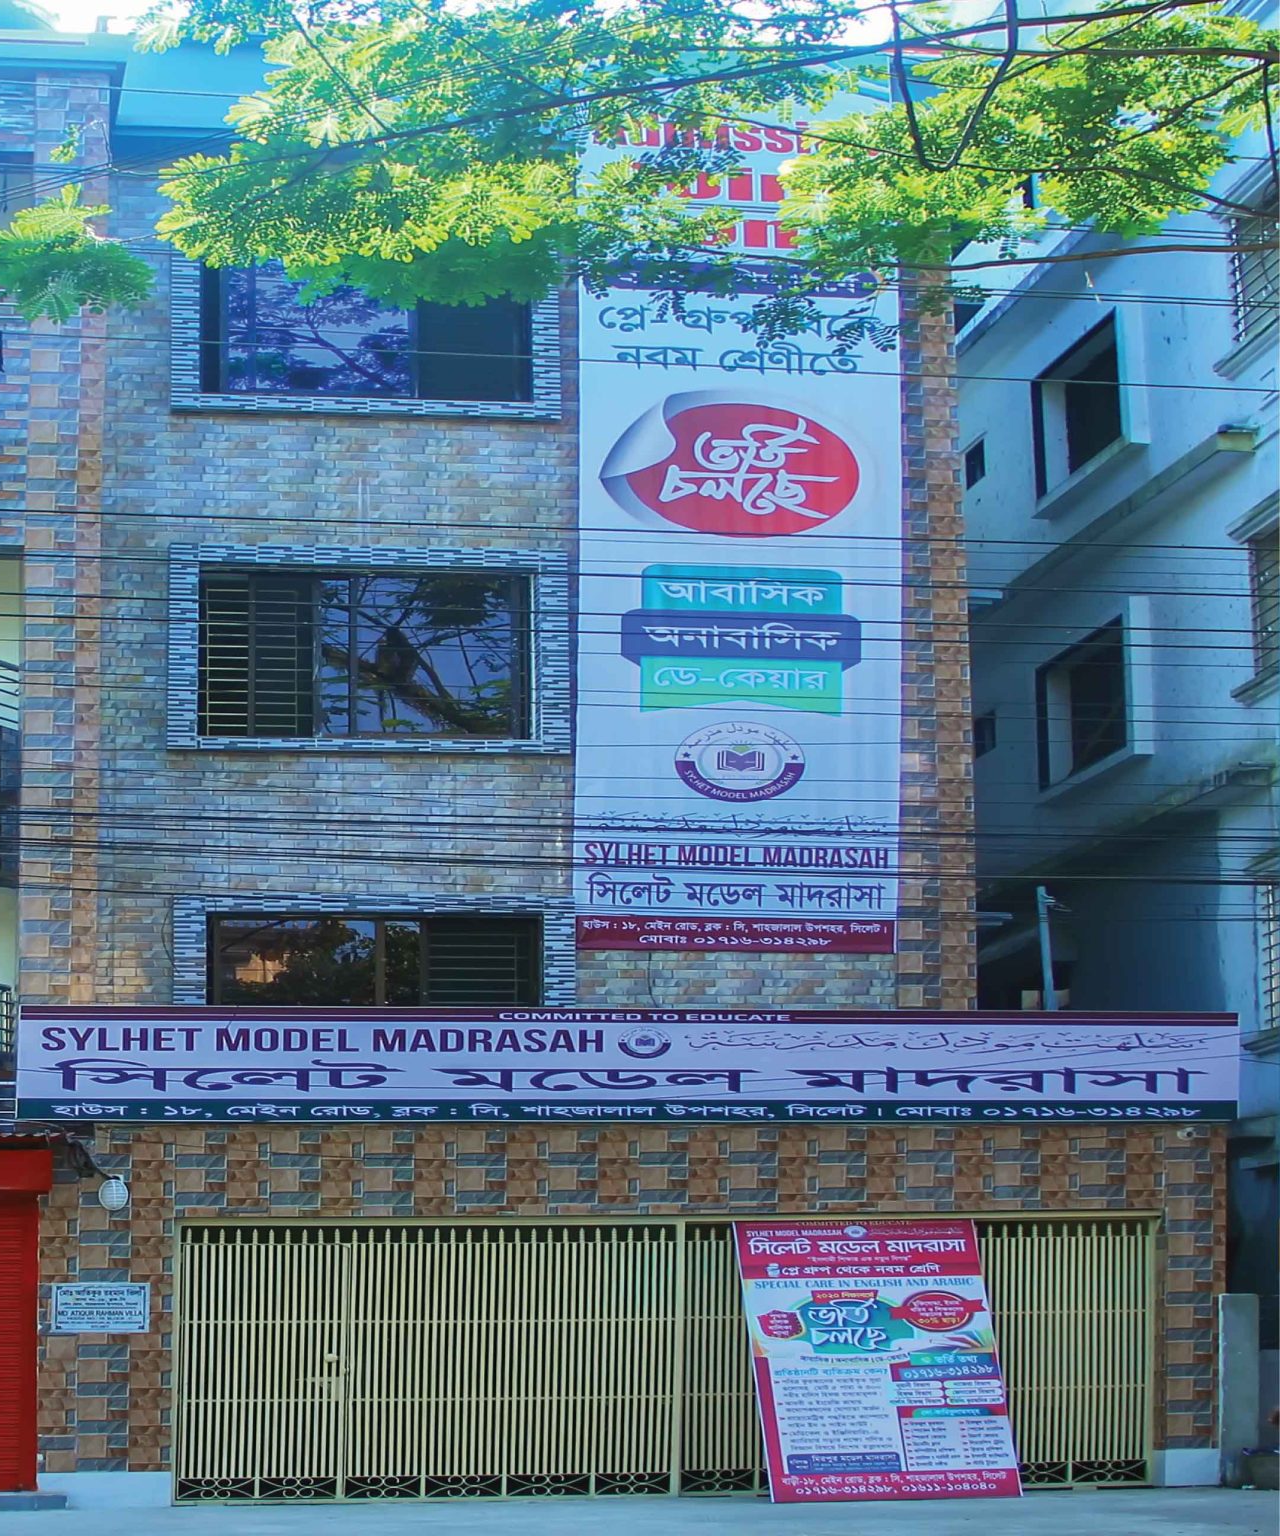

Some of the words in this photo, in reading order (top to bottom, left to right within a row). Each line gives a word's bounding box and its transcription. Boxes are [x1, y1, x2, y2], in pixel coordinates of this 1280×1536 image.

[611, 345, 705, 371] নবম
[719, 342, 864, 376] শ্রেণীতে
[659, 464, 840, 519] চলছে
[657, 578, 829, 606] আবাসিক
[641, 622, 842, 652] অনাবাসিক
[653, 666, 829, 692] ডে-কেয়ার
[684, 769, 711, 792] SYLHET
[710, 787, 749, 800] MODEL
[748, 771, 797, 800] MADRASAH
[584, 842, 671, 866] SYLHET
[678, 844, 760, 868] MODEL
[763, 846, 889, 869] MADRASAH
[585, 872, 675, 906] সিলেট
[683, 882, 767, 908] মডেল
[774, 881, 887, 910] মাদরাসা
[582, 918, 610, 930] হাউস
[622, 921, 641, 931] ১৮,
[645, 919, 671, 931] মেইন
[675, 921, 702, 932] রোড,
[752, 922, 802, 933] শাহজালাল
[850, 922, 881, 934] সিলেট
[694, 935, 832, 947] ০১৭১৬-৩১৪২৯৮
[498, 1012, 643, 1022] COMMITTED
[648, 1012, 681, 1022] TO
[689, 1013, 791, 1023] EDUCATE
[41, 1027, 202, 1052] SYLHET
[215, 1027, 360, 1053] MODEL
[372, 1028, 604, 1054] MADRASAH
[38, 1058, 407, 1093] সিলেট
[430, 1067, 763, 1094] মডেল
[786, 1065, 1209, 1095] মাদরাসা
[50, 1103, 128, 1118] হাউস
[163, 1106, 213, 1119] ১৮,
[226, 1104, 301, 1118] মেইন
[310, 1105, 381, 1119] রোড,
[391, 1106, 438, 1119] ব্লক
[470, 1103, 510, 1118] সি,
[521, 1105, 654, 1118] শাহজালাল
[664, 1104, 775, 1119] উপশহর,
[785, 1103, 867, 1119] সিলেট
[895, 1106, 970, 1118] মোবাঃ
[982, 1107, 1202, 1119] ০১৭১৬-৩১৪২৯৮
[746, 1230, 774, 1238] SYLHET
[801, 1229, 842, 1237] MADRASAH
[747, 1237, 812, 1255] সিলেট
[816, 1240, 880, 1254] মডেল
[884, 1239, 966, 1253] মাদরাসা
[836, 1265, 871, 1275] থেকে
[873, 1264, 905, 1274] নবম
[754, 1280, 801, 1290] SPECIAL
[805, 1280, 836, 1289] CARE
[838, 1280, 851, 1288] IN
[854, 1279, 901, 1288] ENGLISH
[905, 1278, 929, 1287] AND
[930, 1277, 974, 1287] ARABIC
[807, 1298, 878, 1327] ভর্তি
[809, 1327, 902, 1352] চলছে
[903, 1364, 994, 1379] ০১৭১৬-৩১৪২৯৮
[901, 1481, 997, 1492] ০১৬১১-১০৪০৪০
